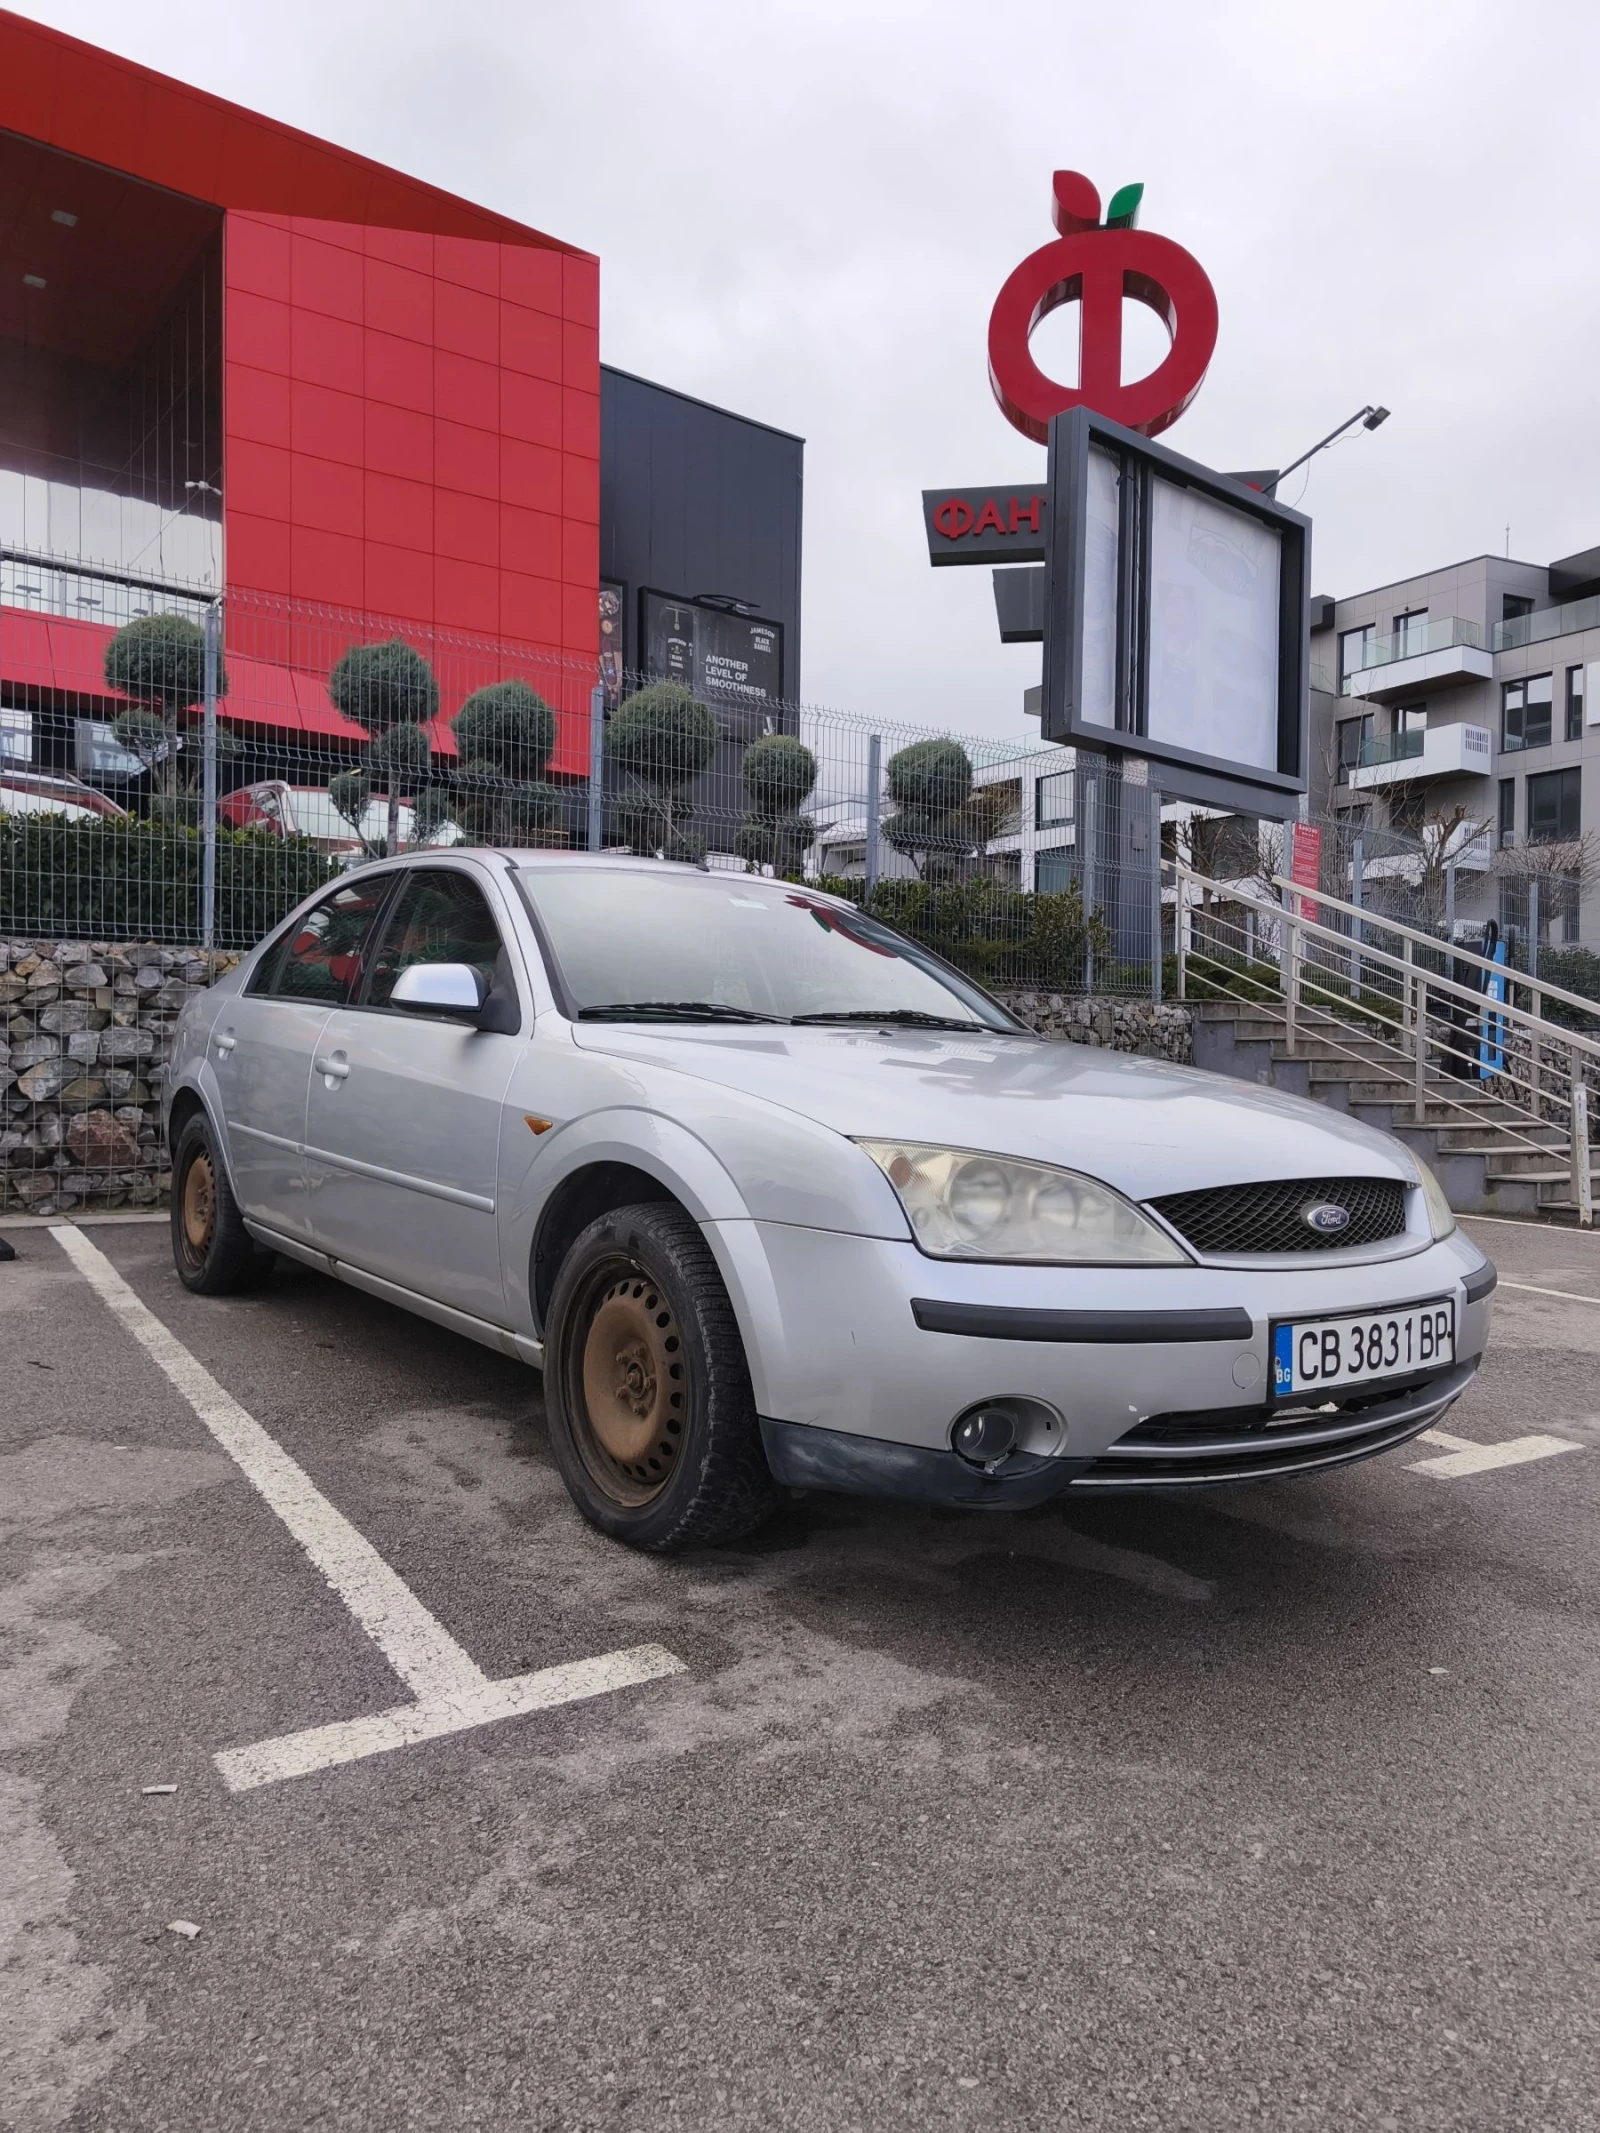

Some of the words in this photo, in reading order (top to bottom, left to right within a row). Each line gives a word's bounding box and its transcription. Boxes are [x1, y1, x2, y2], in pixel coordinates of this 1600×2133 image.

[933, 496, 1047, 540] ФАН
[750, 627, 775, 639] JAMESON
[755, 636, 770, 645] BLACK
[705, 654, 749, 671] ANOTHER
[705, 665, 733, 679] LEVEL
[734, 672, 748, 682] OF
[705, 676, 767, 697] SMOOTHNESS
[1321, 1210, 1342, 1225] Ford
[1299, 1329, 1341, 1381] CB
[1347, 1317, 1413, 1373] 3831
[1420, 1310, 1449, 1360] BP
[1275, 1368, 1291, 1384] BG
